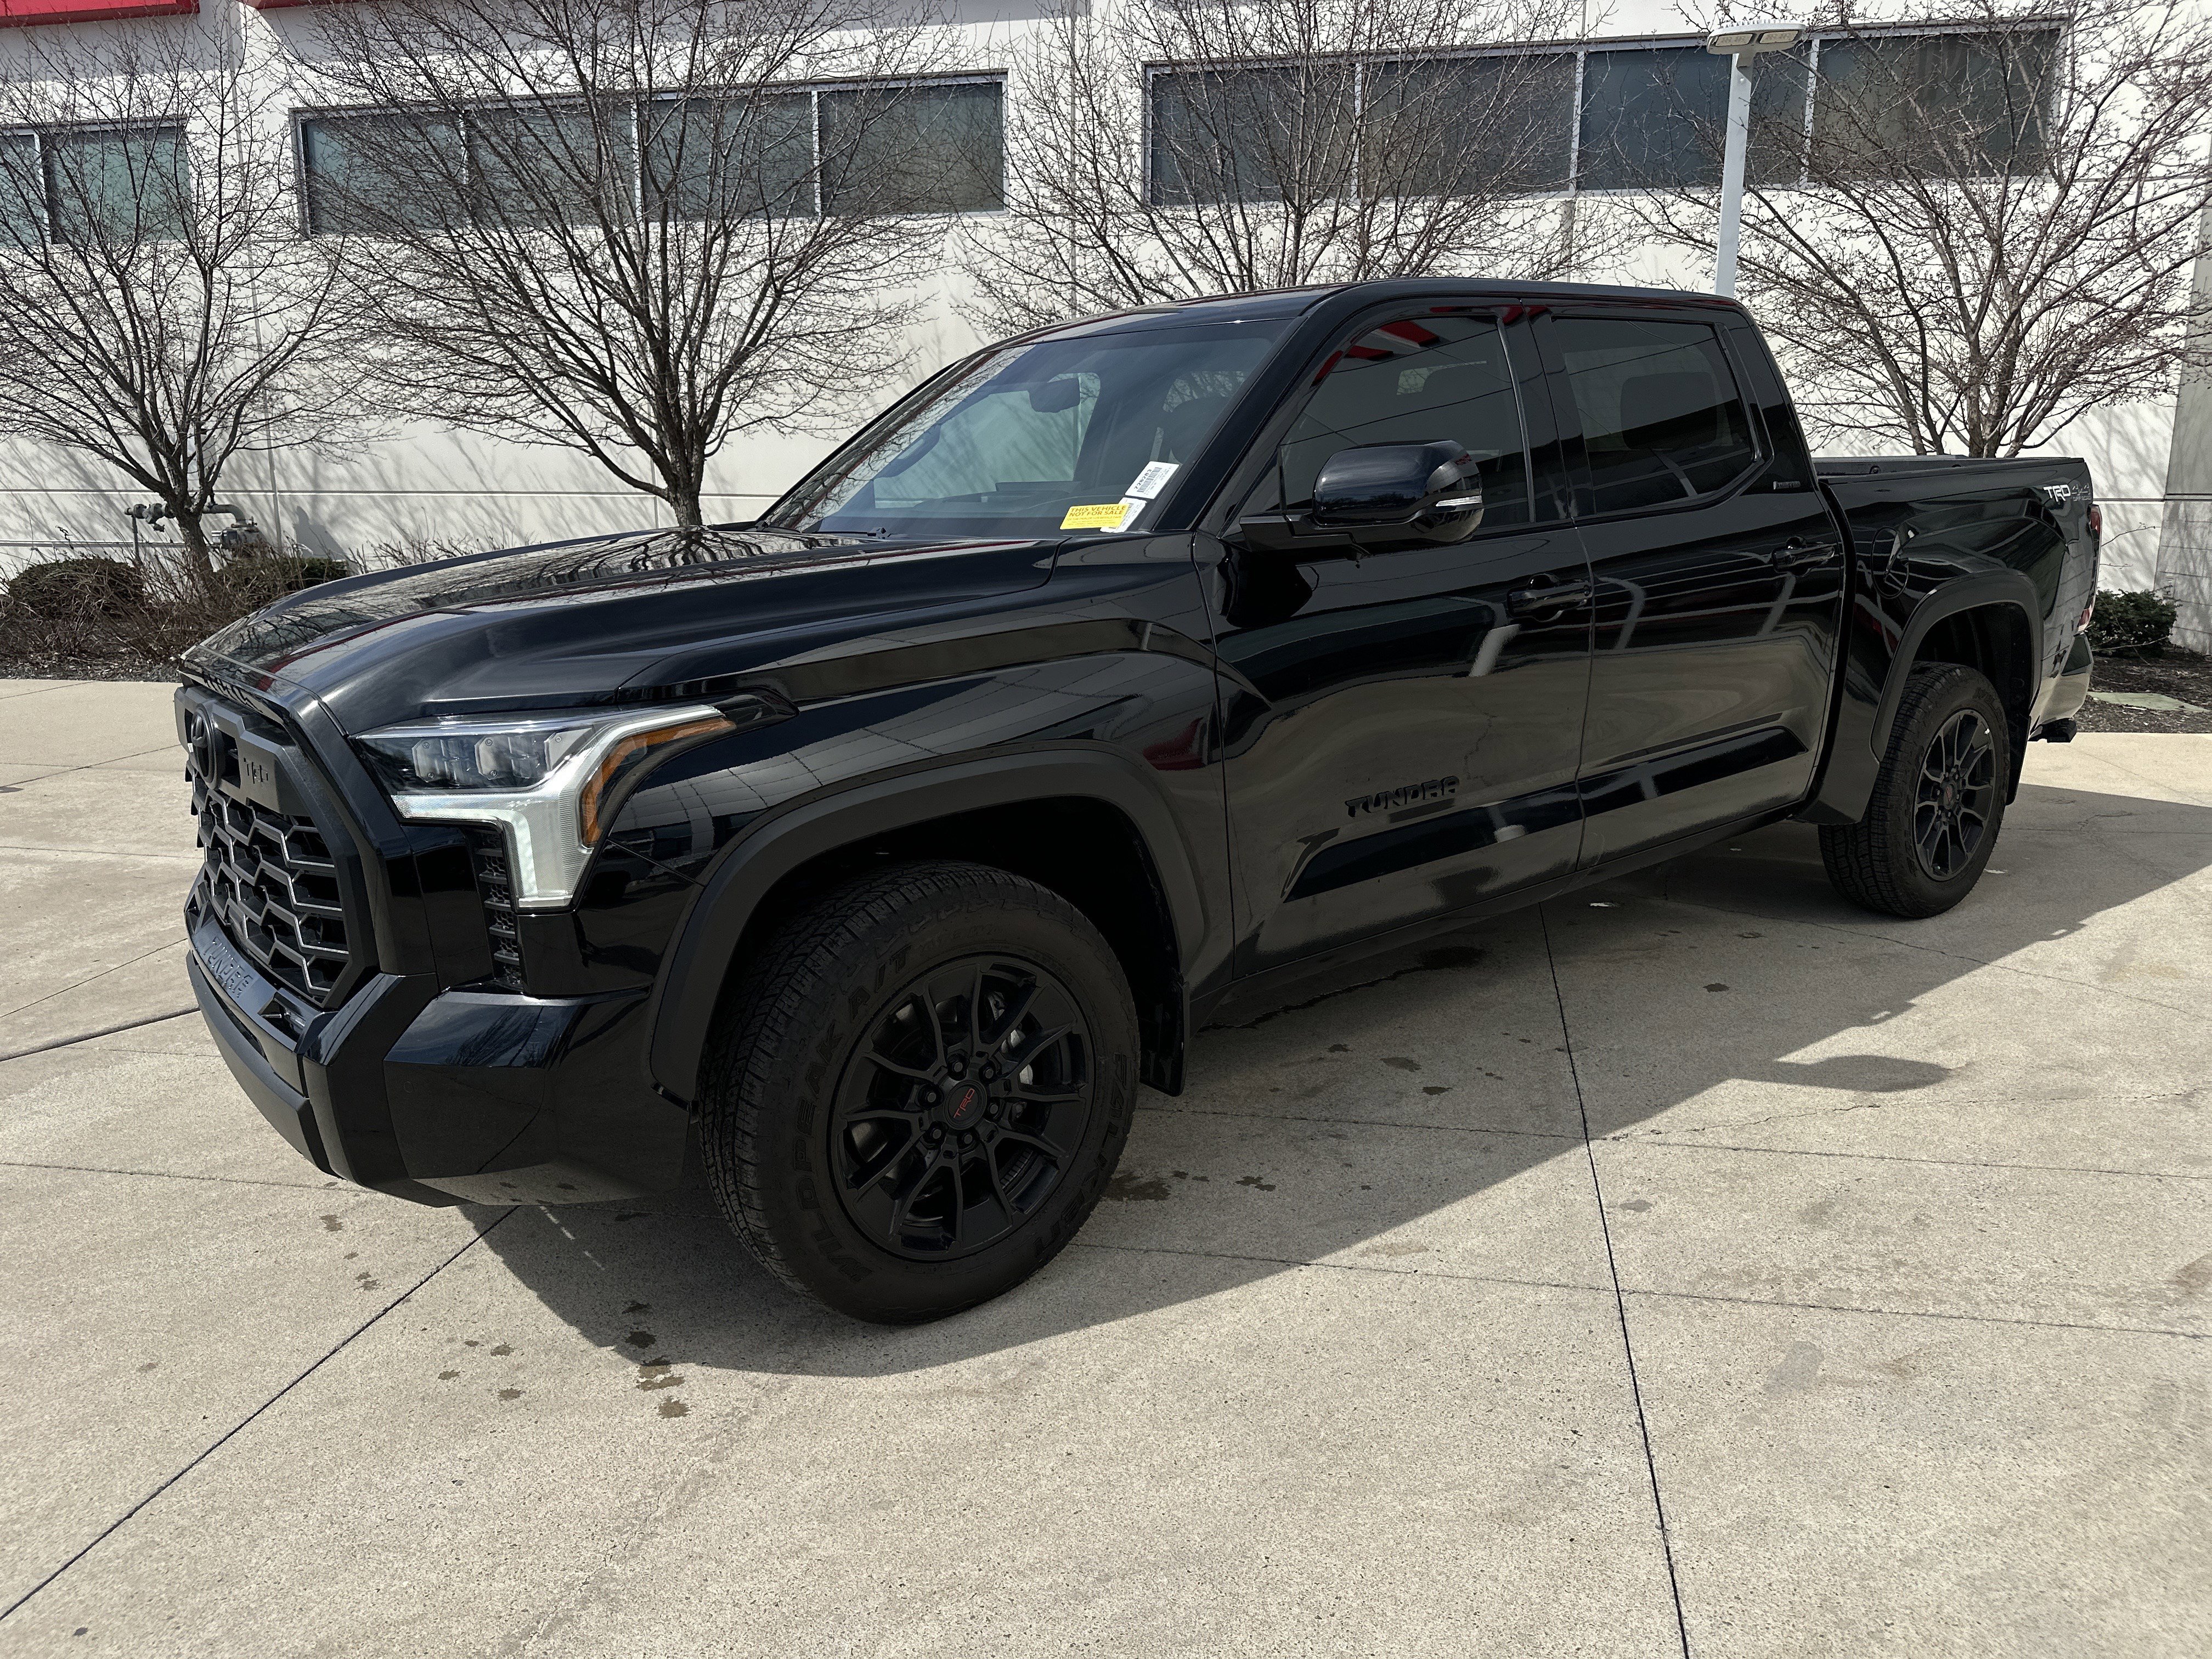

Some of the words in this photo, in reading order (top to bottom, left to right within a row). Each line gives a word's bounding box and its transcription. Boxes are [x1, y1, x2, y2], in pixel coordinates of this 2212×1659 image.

[2043, 484, 2071, 502] TRD
[1344, 775, 1460, 818] TUNDRA
[953, 1088, 975, 1119] TRD
[792, 1022, 874, 1284] WILDPEAK
